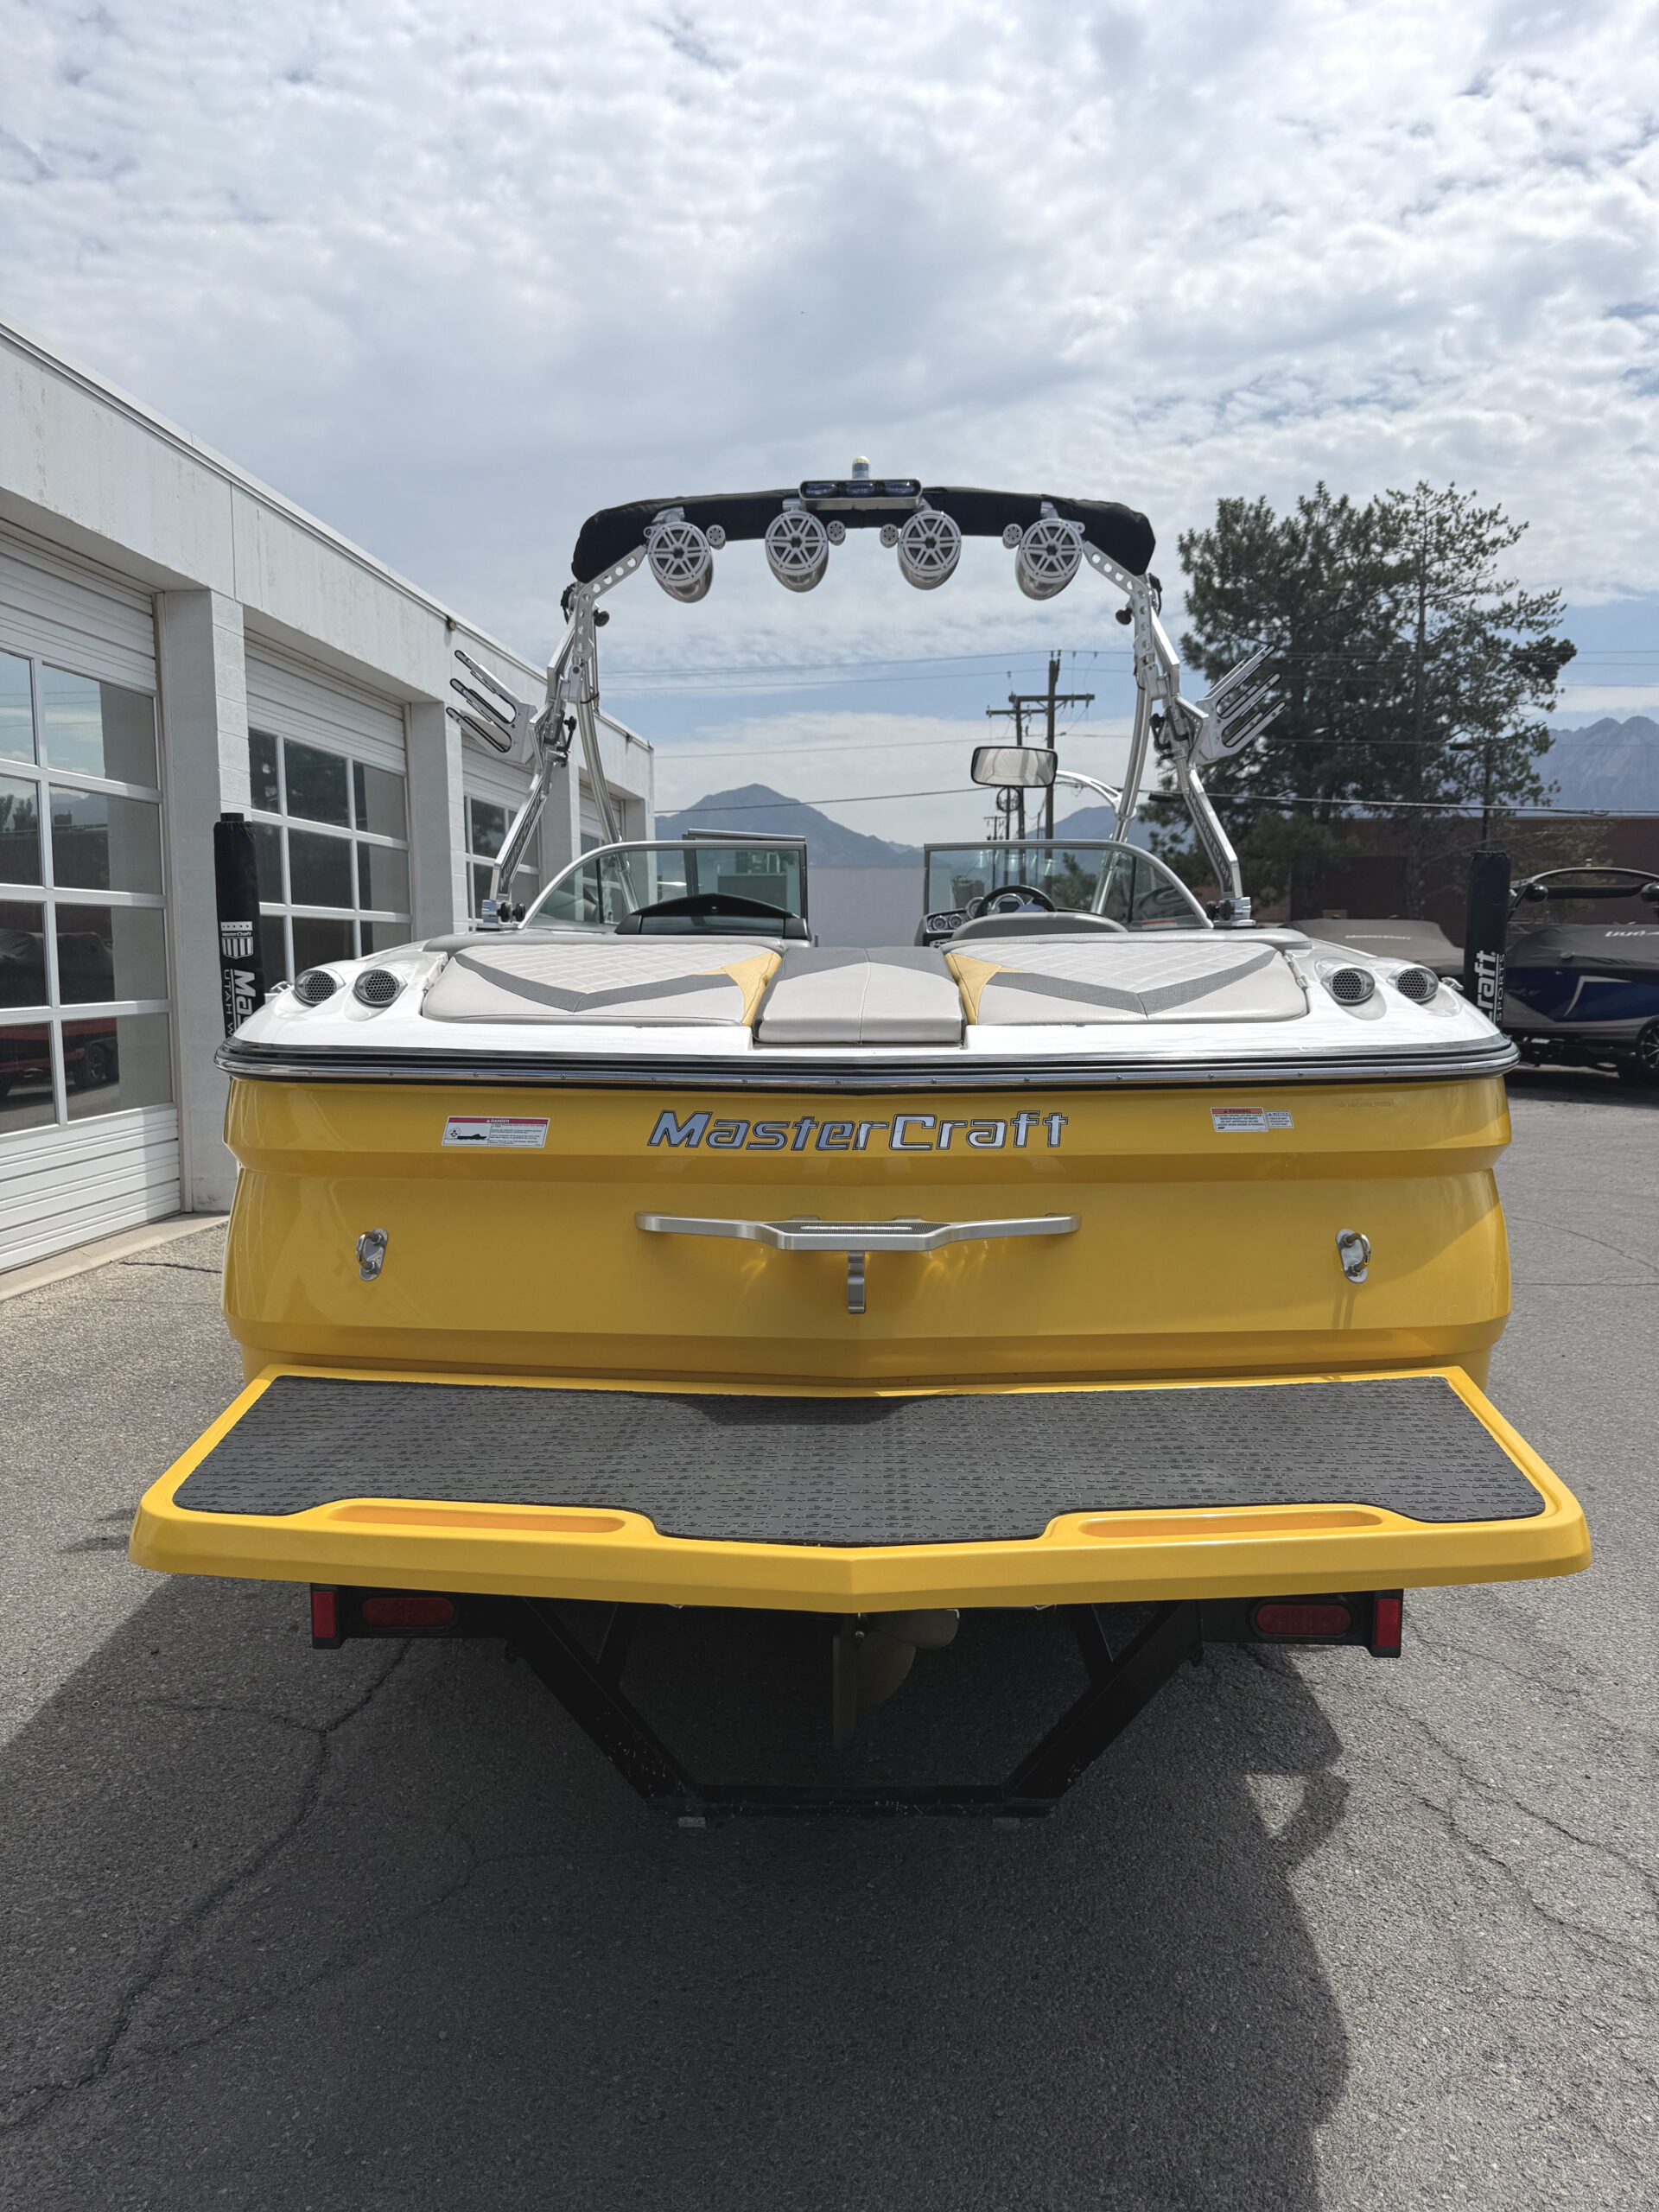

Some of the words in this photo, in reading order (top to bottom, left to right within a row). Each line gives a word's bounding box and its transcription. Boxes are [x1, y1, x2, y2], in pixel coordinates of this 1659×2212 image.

[224, 969, 232, 1014] UTAH
[1497, 954, 1505, 1021] SPORTS
[647, 1109, 1069, 1151] MasterCraft
